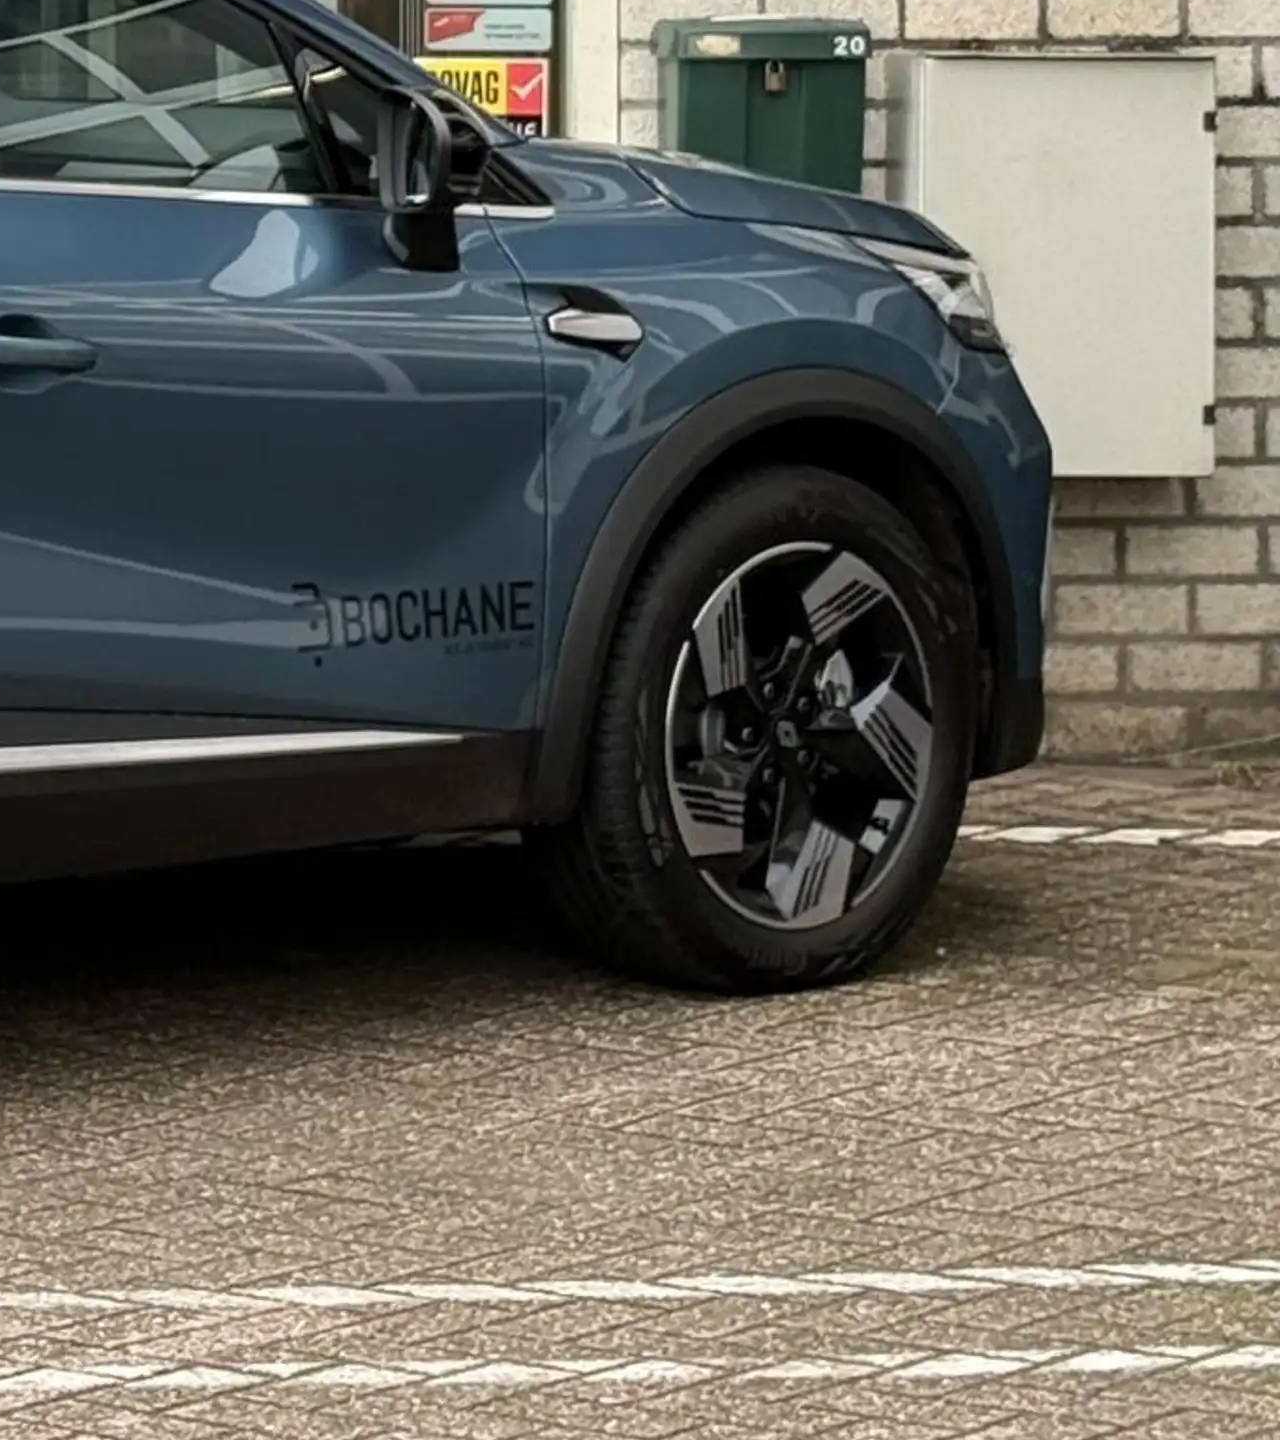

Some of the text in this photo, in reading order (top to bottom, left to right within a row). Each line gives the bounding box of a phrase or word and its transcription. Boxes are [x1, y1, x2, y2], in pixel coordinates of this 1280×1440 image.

[833, 35, 866, 56] 20
[429, 69, 500, 105] OVAG
[341, 580, 536, 649] BOCHANE
